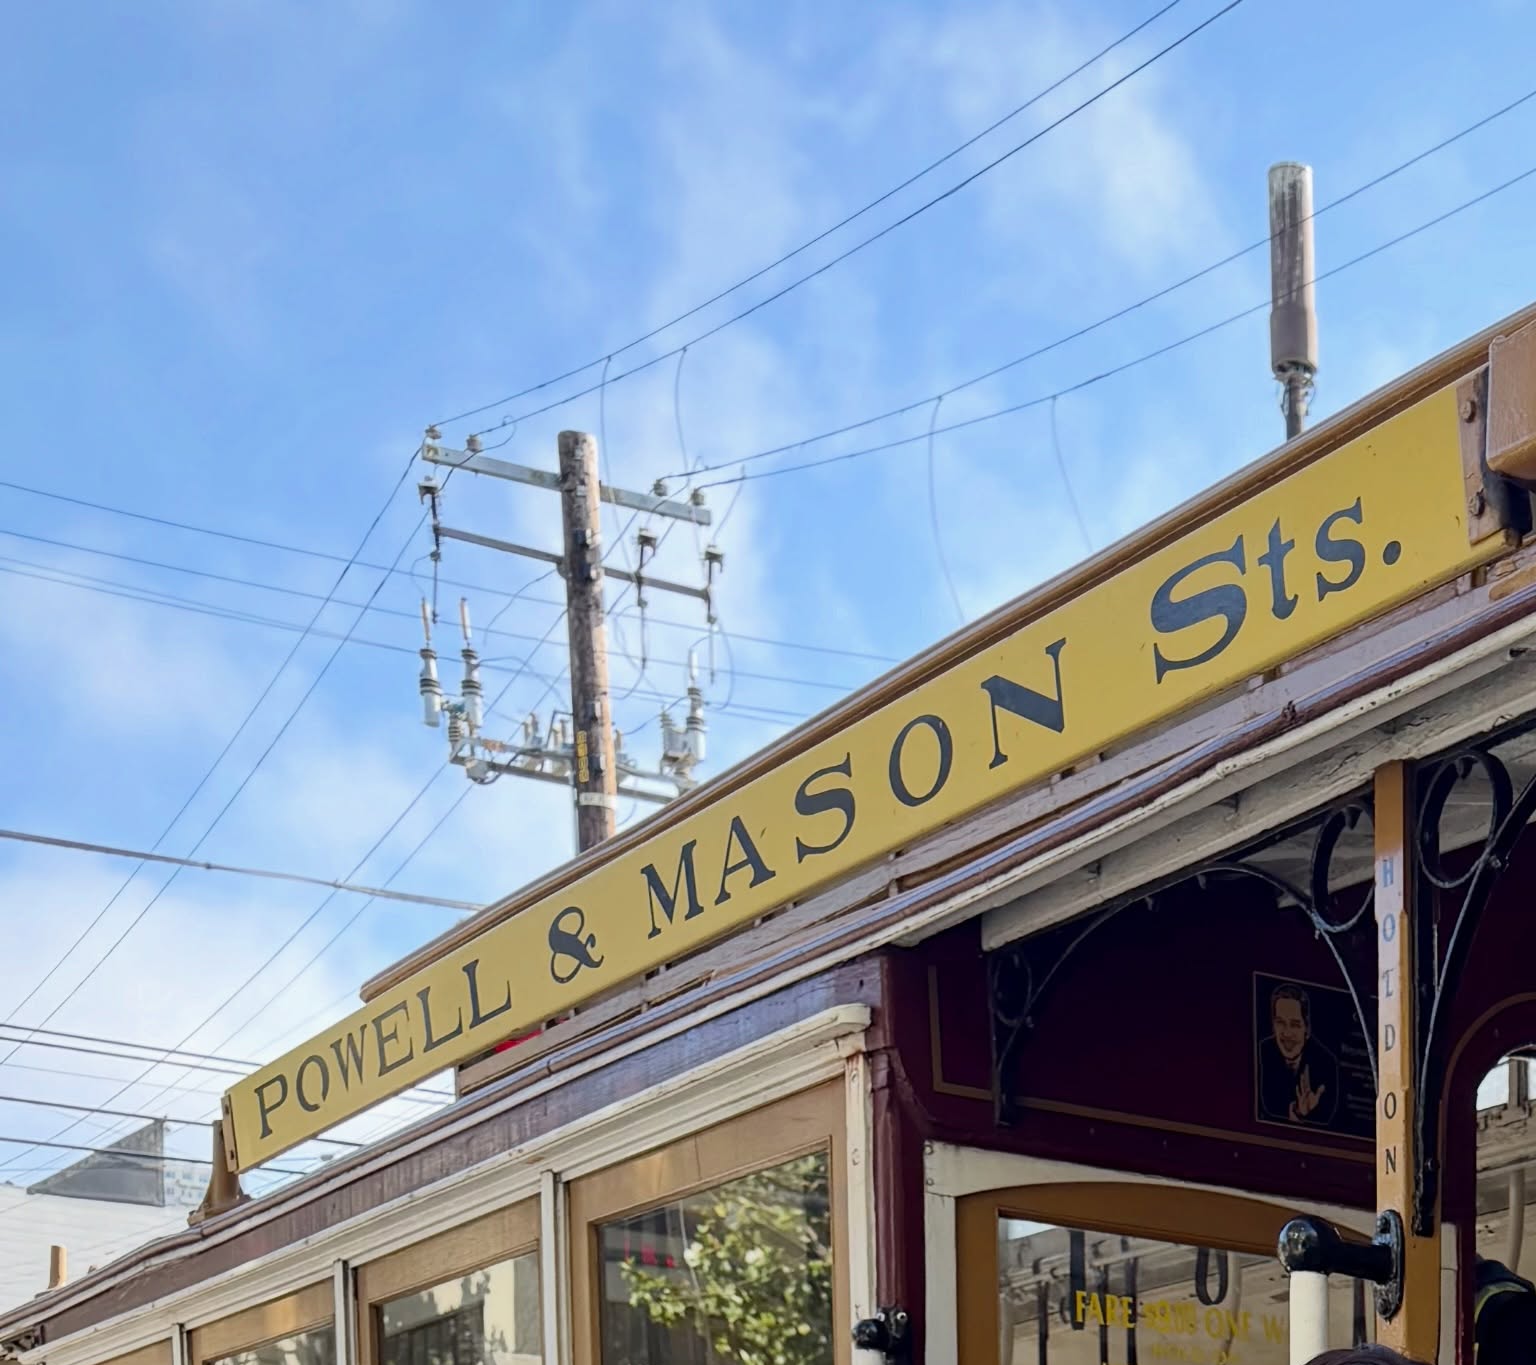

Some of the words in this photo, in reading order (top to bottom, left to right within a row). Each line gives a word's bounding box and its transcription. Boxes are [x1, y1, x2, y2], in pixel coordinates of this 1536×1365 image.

[252, 958, 513, 1140] POWELL
[547, 905, 604, 985] &
[639, 637, 1067, 940] MASON
[1150, 496, 1402, 684] Sts.
[1075, 1290, 1136, 1328] FARE
